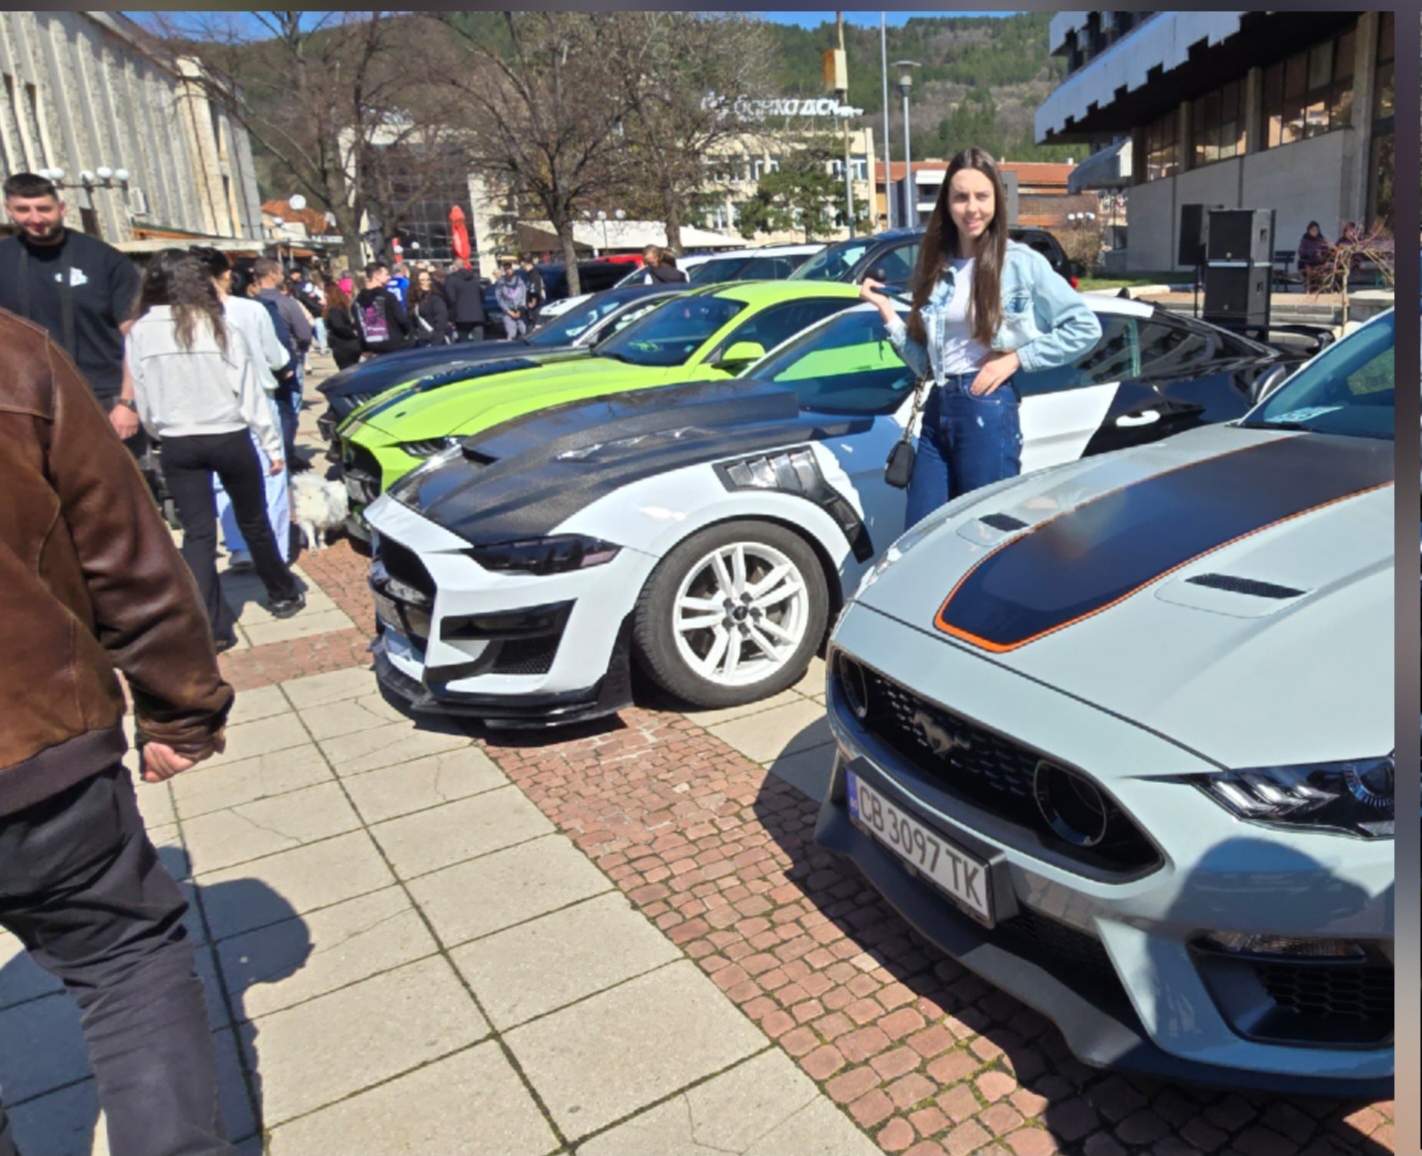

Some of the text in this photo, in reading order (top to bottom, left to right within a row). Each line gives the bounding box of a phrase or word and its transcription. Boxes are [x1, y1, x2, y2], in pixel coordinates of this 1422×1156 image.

[859, 785, 983, 907] CB 3097 TK
